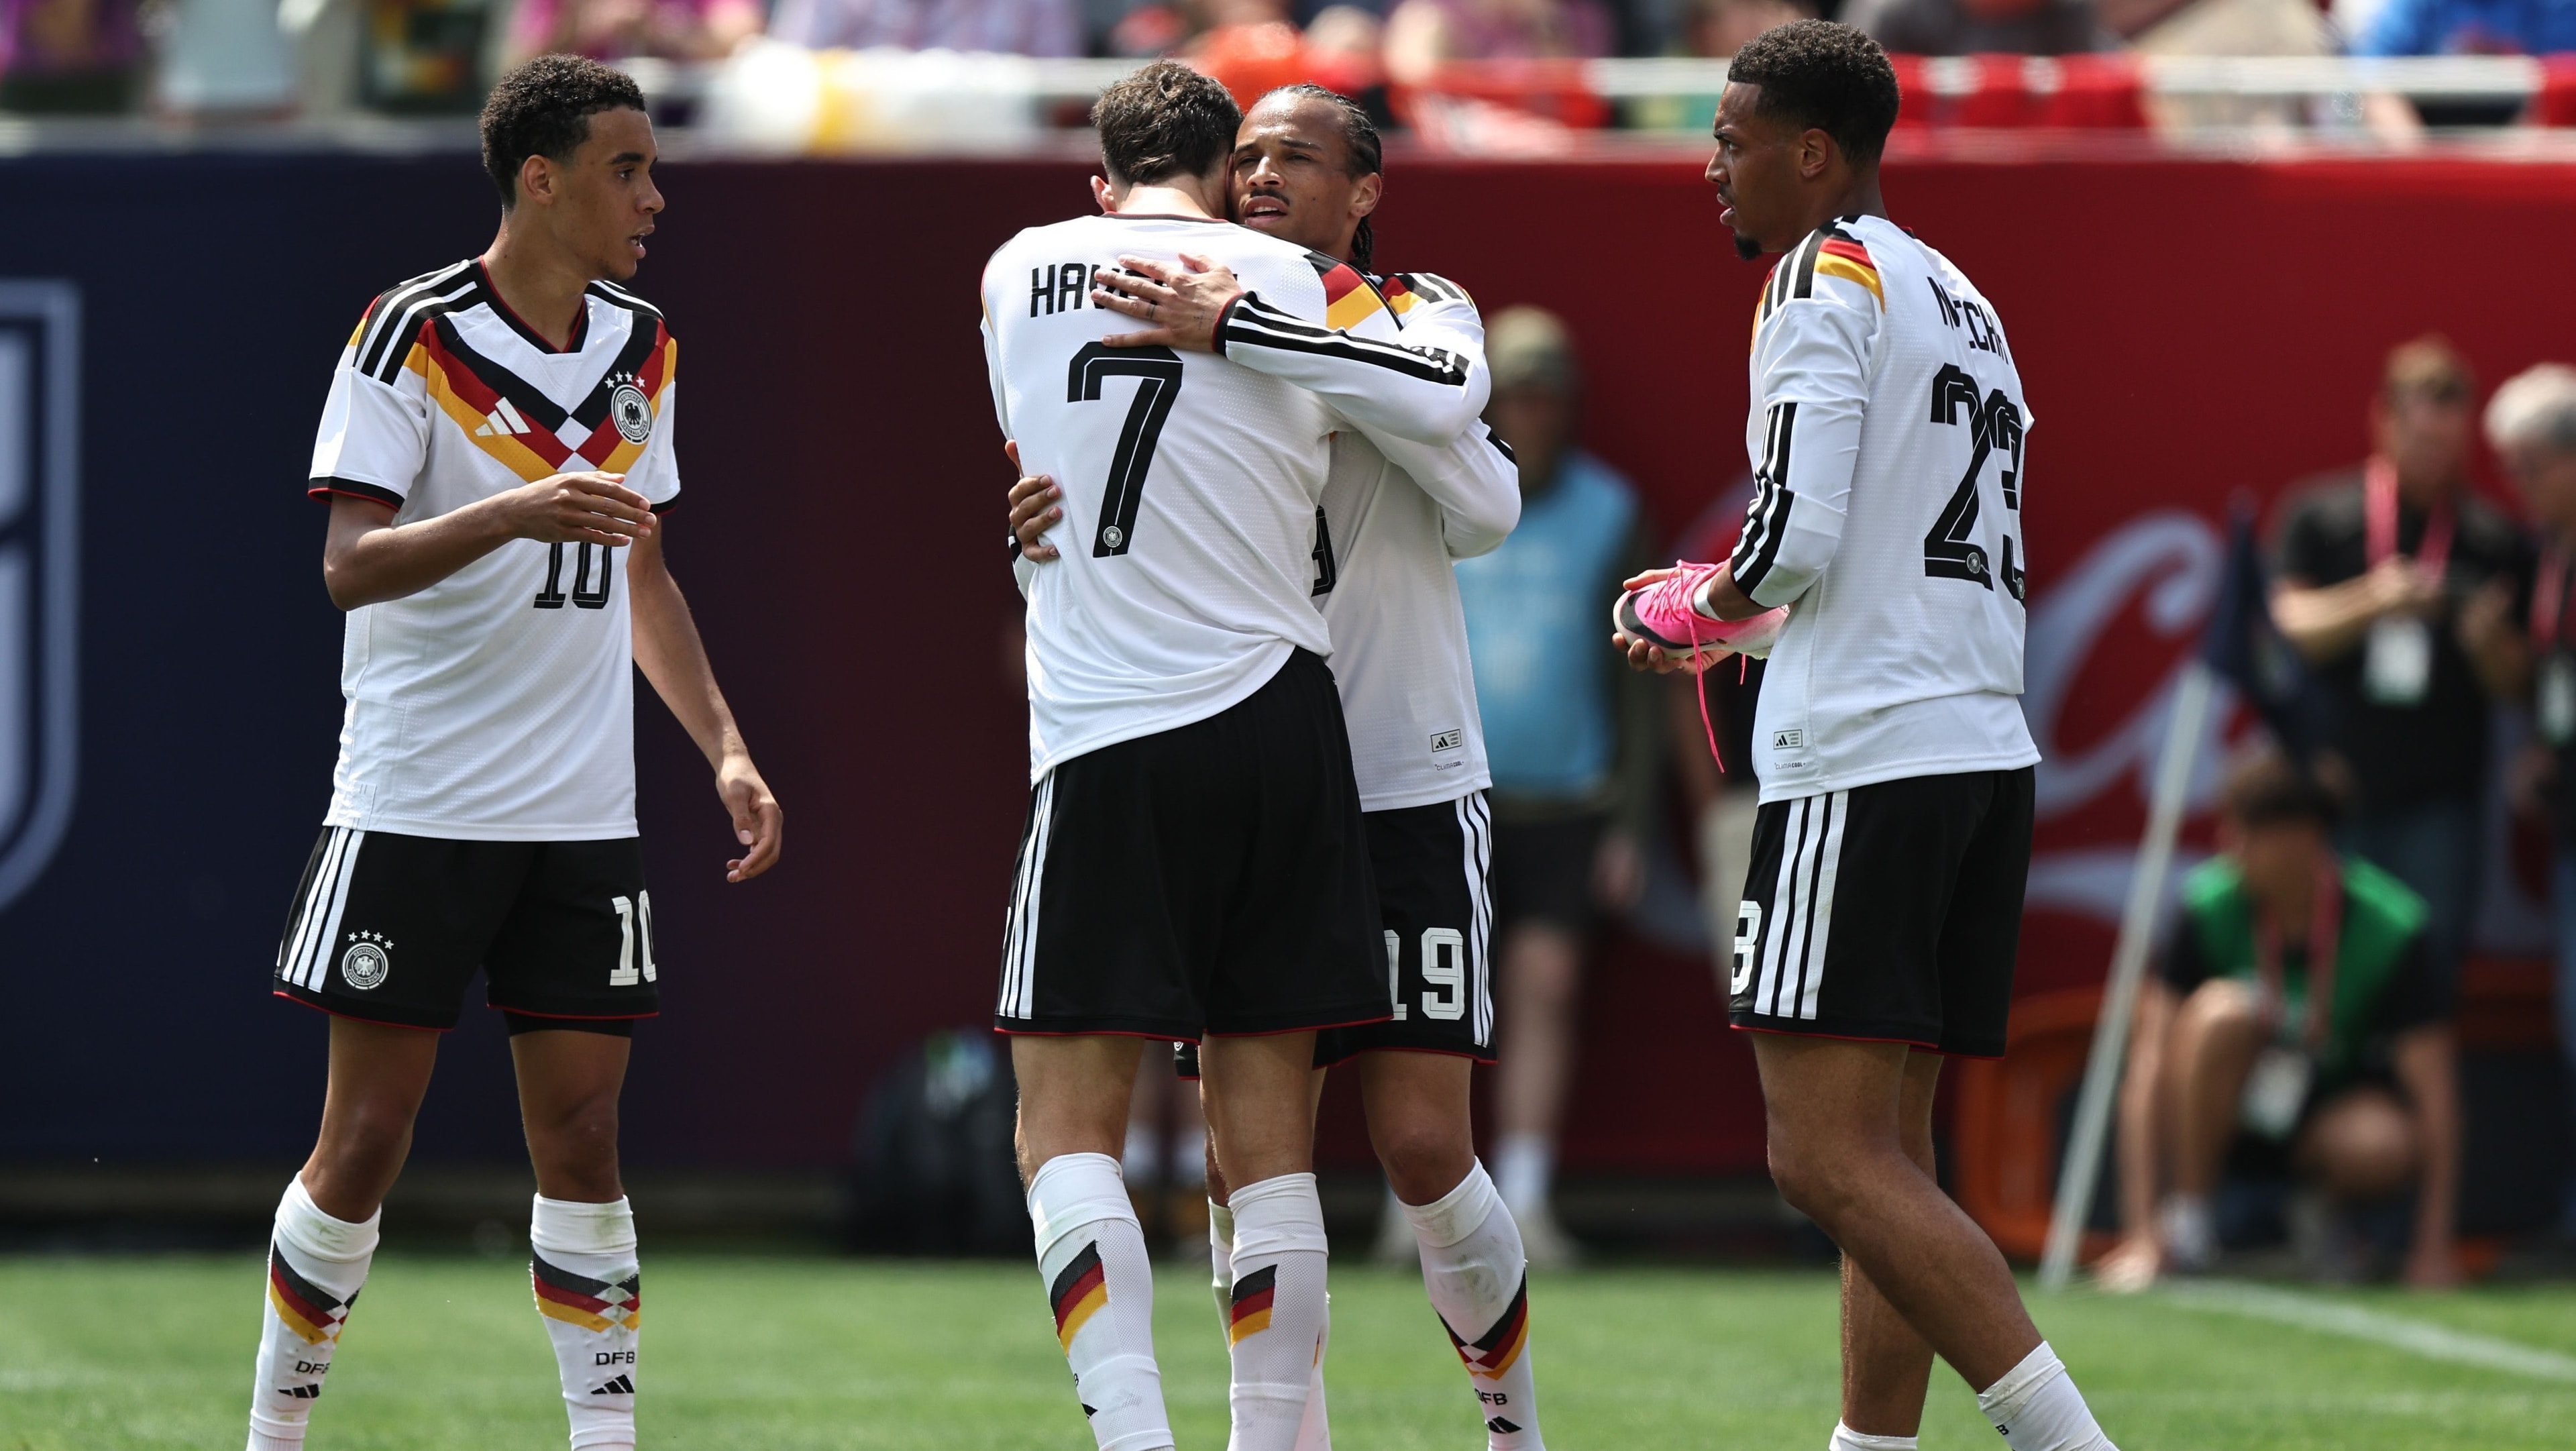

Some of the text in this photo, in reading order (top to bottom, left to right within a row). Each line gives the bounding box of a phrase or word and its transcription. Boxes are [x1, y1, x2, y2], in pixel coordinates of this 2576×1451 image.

[1067, 341, 1183, 558] 7
[1924, 362, 2026, 609] 23
[1383, 927, 1465, 1020] 19
[596, 1352, 635, 1366] DFB
